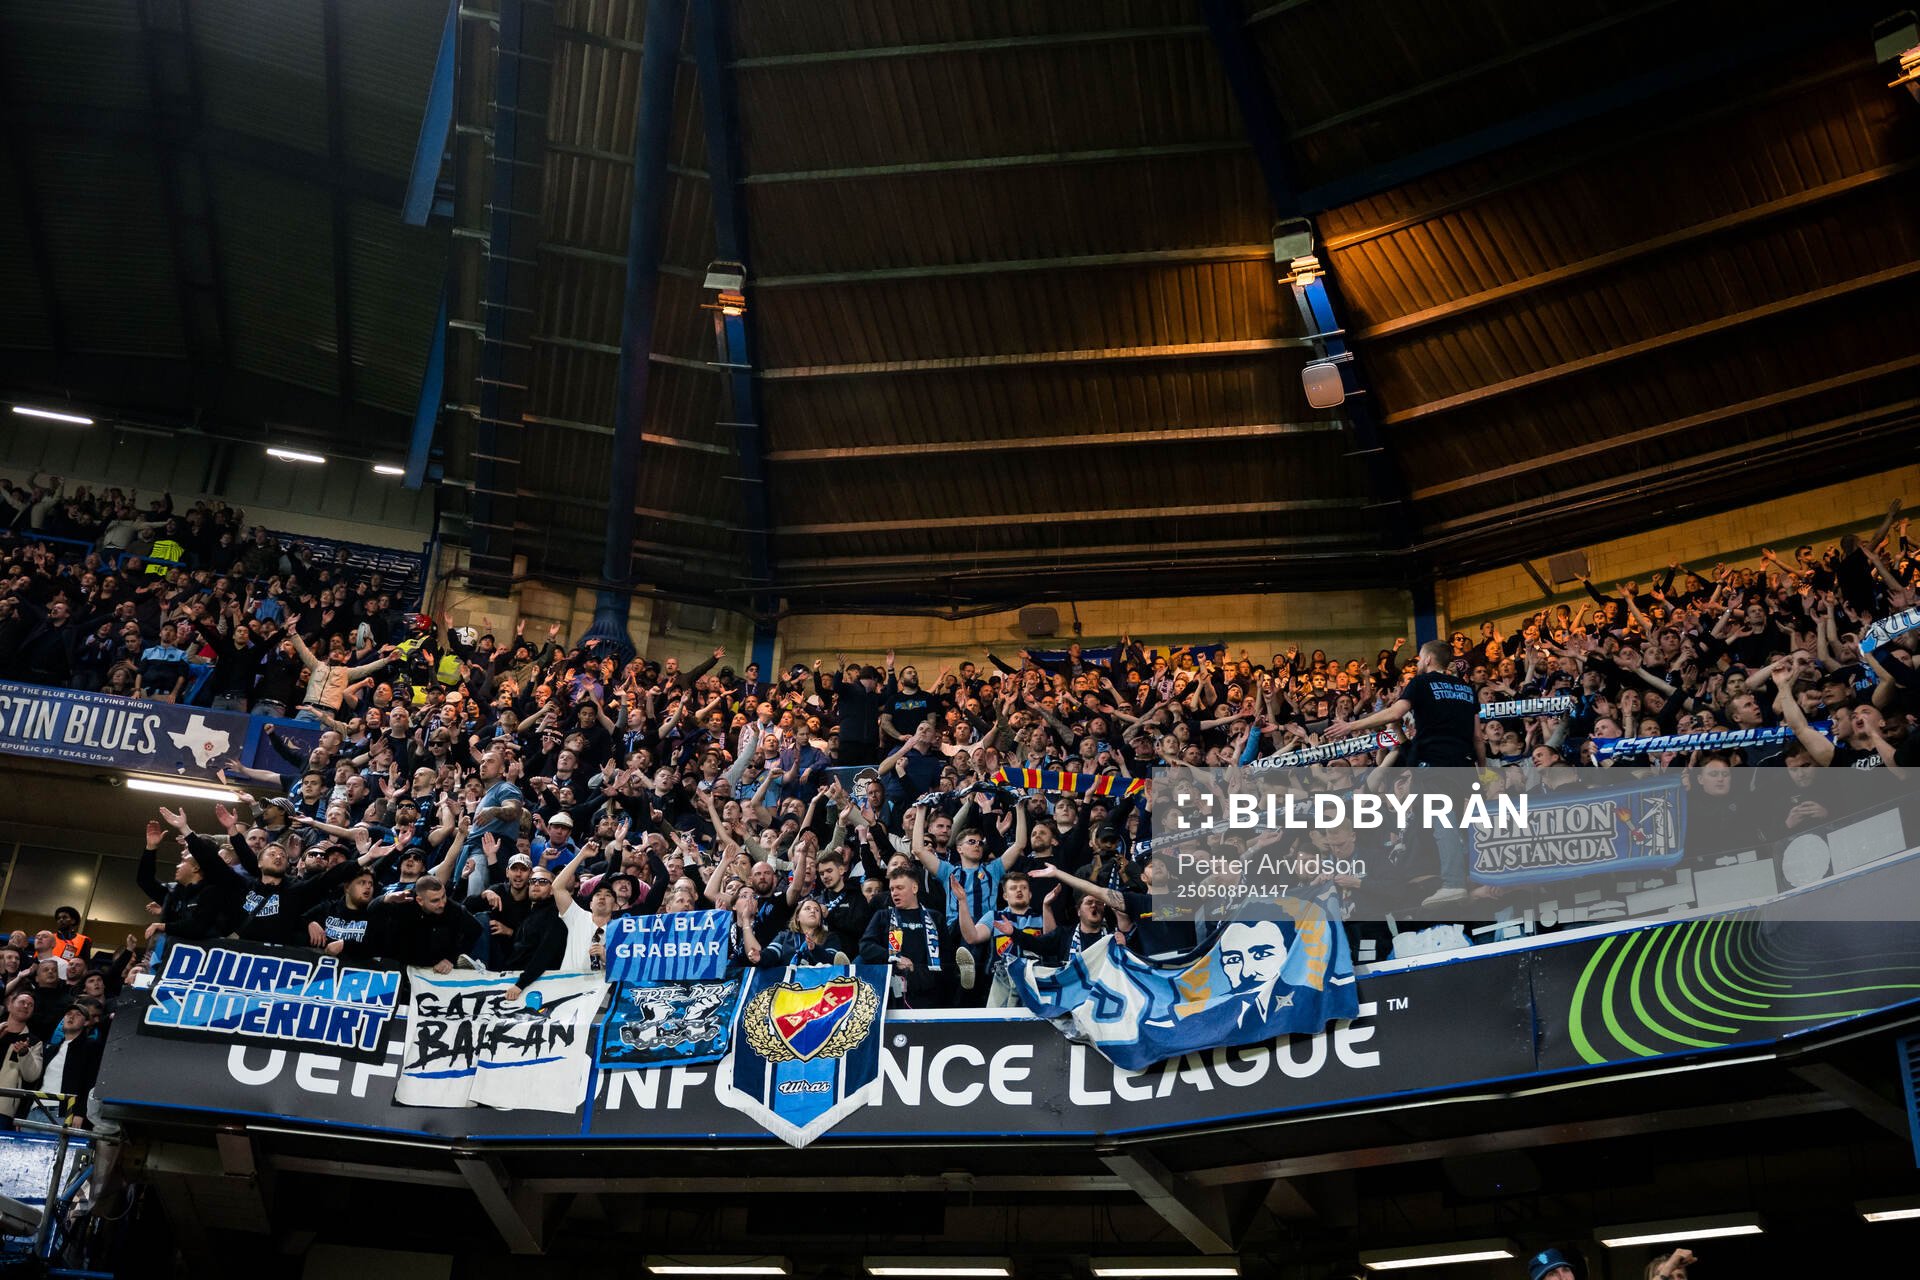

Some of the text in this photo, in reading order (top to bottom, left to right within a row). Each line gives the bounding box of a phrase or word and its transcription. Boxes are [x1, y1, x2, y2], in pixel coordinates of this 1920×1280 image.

[22, 687, 40, 696] THE
[42, 691, 65, 699] BLUE
[68, 693, 91, 702] FLAG
[94, 696, 125, 706] FLYING
[127, 701, 153, 710] HIGH!
[1486, 700, 1518, 717] FOR
[58, 750, 87, 759] TEXAS
[622, 911, 716, 933] BLÅ BLÅ
[615, 941, 720, 958] GRABBAR
[162, 943, 401, 1008] DJURGÅRN
[629, 986, 687, 1005] FREE
[145, 983, 392, 1051] SÖDERORT
[227, 1041, 403, 1098] UEF
[1068, 1001, 1381, 1106] LEAGUE
[1386, 996, 1409, 1011] TM
[405, 1011, 579, 1071] BALKAN
[778, 1080, 831, 1095] Ultras
